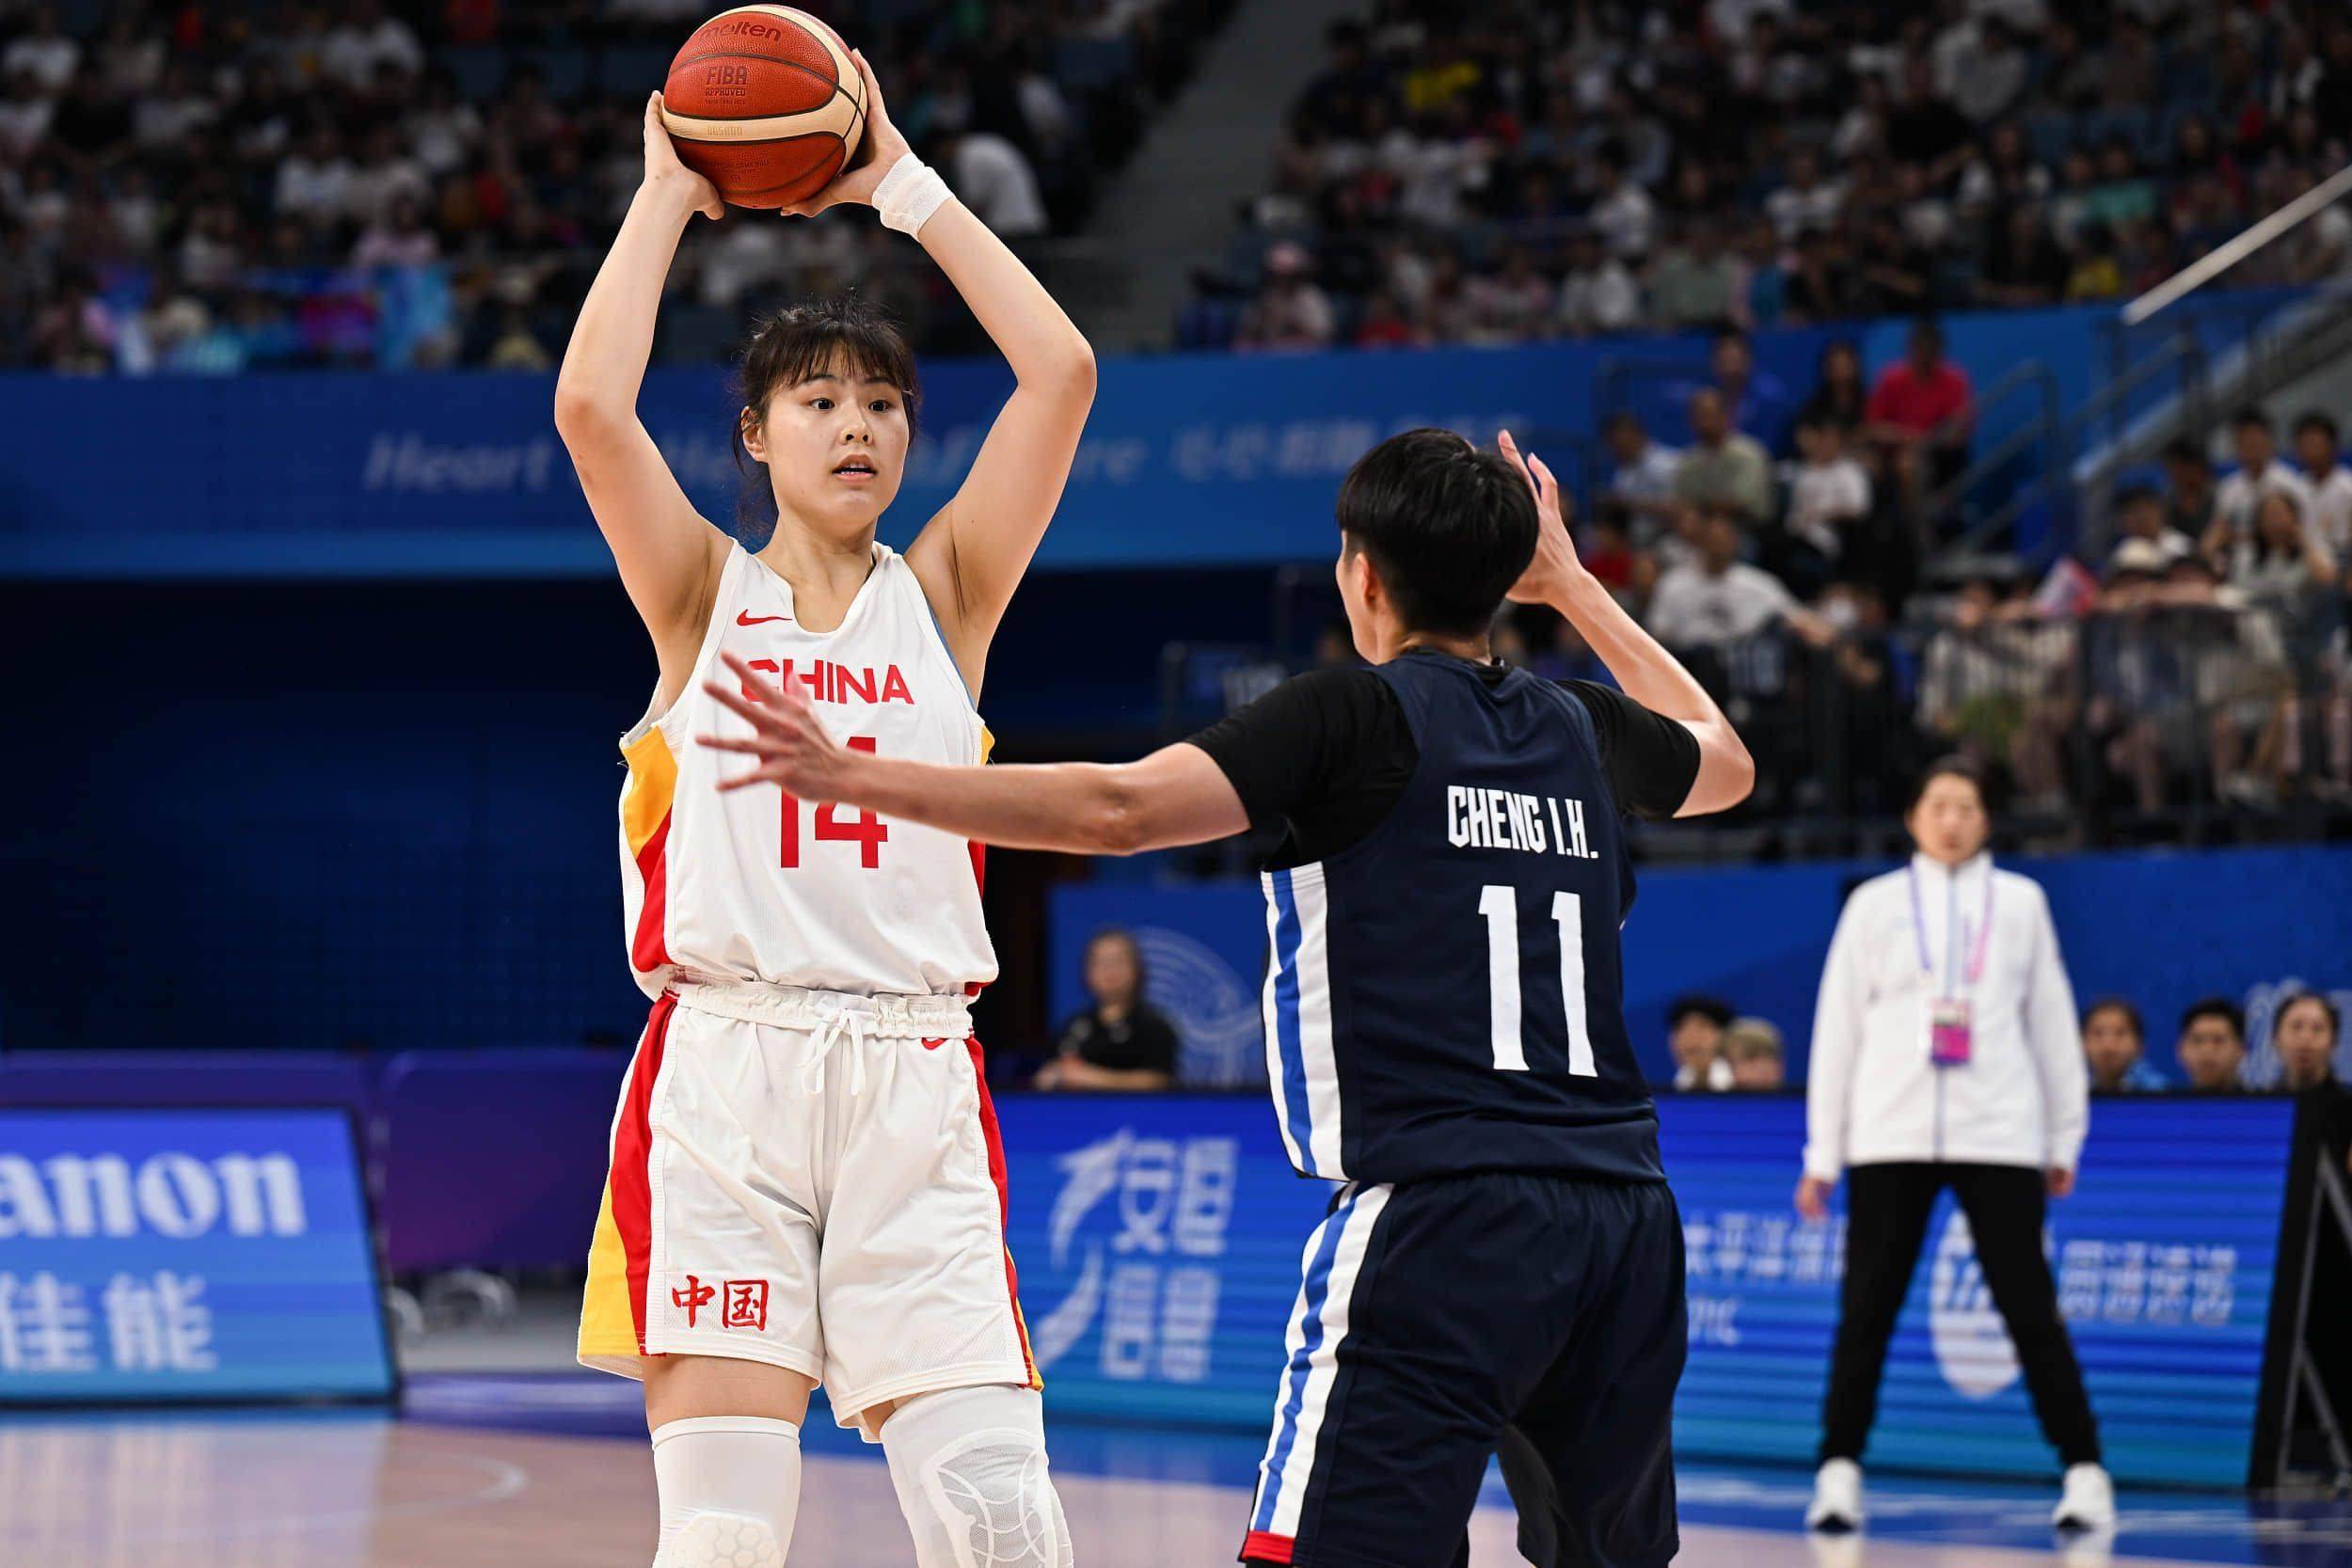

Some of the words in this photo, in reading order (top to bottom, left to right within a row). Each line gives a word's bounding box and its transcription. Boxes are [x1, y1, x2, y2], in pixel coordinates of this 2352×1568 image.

[698, 21, 782, 43] molten
[705, 87, 746, 97] APPROVED
[707, 65, 748, 86] FIBA
[739, 658, 915, 705] CHINA
[779, 736, 888, 869] 14
[1447, 784, 1548, 854] CHENG
[1547, 797, 1599, 859] I.H.
[1478, 884, 1599, 1078] 11
[672, 1275, 770, 1331] 中国
